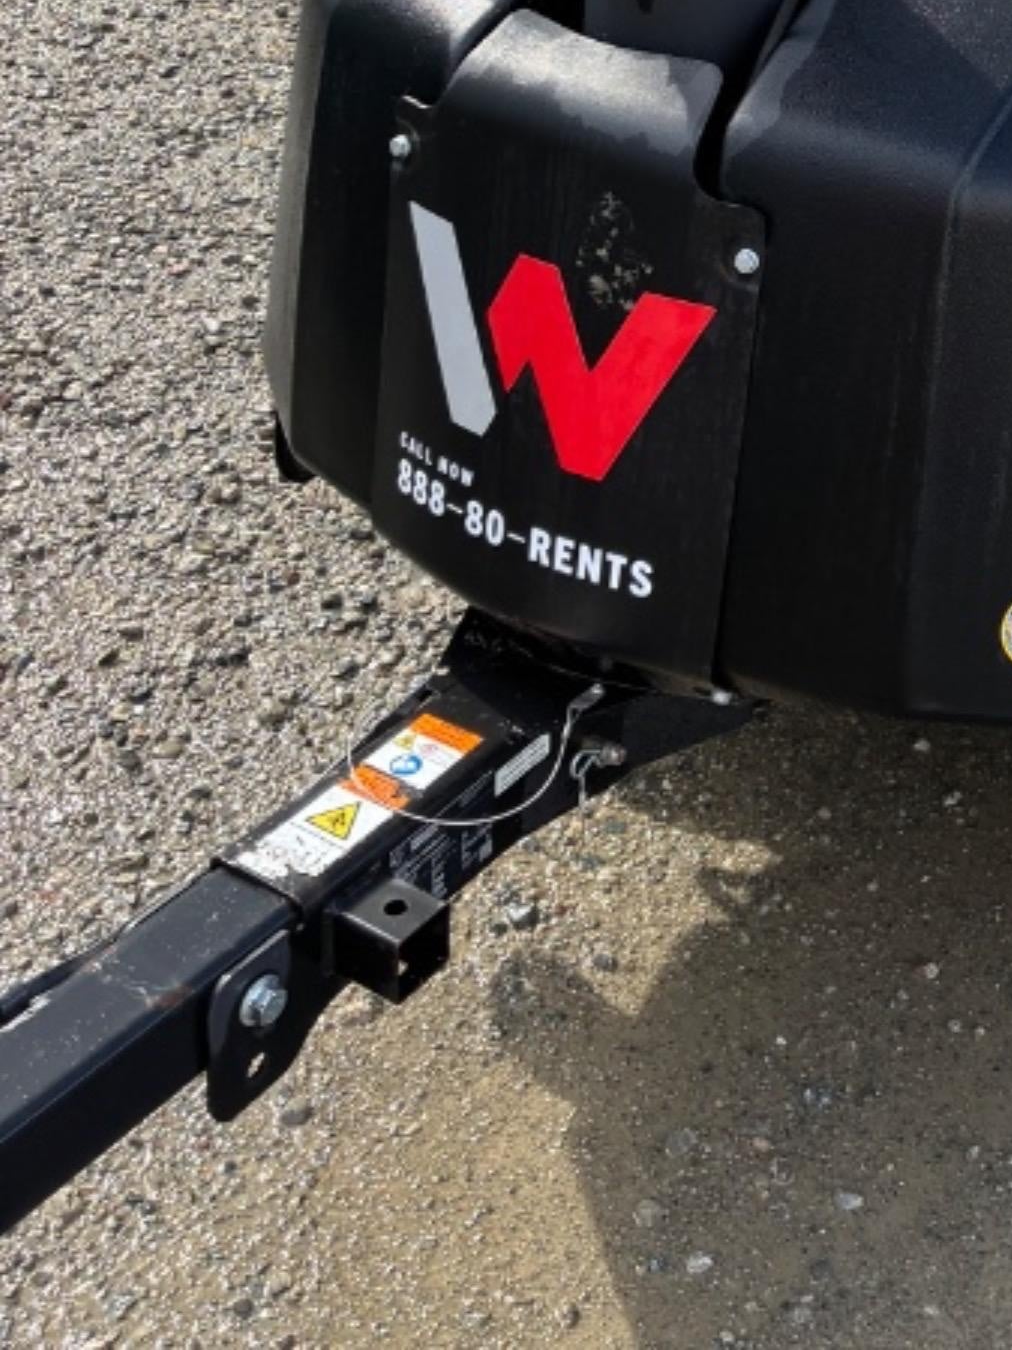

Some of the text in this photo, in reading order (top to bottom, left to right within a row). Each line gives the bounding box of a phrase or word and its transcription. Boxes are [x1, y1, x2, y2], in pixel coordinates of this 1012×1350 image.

[400, 431, 475, 487] CALL NOW
[398, 458, 654, 598] 888-80-RENTS
